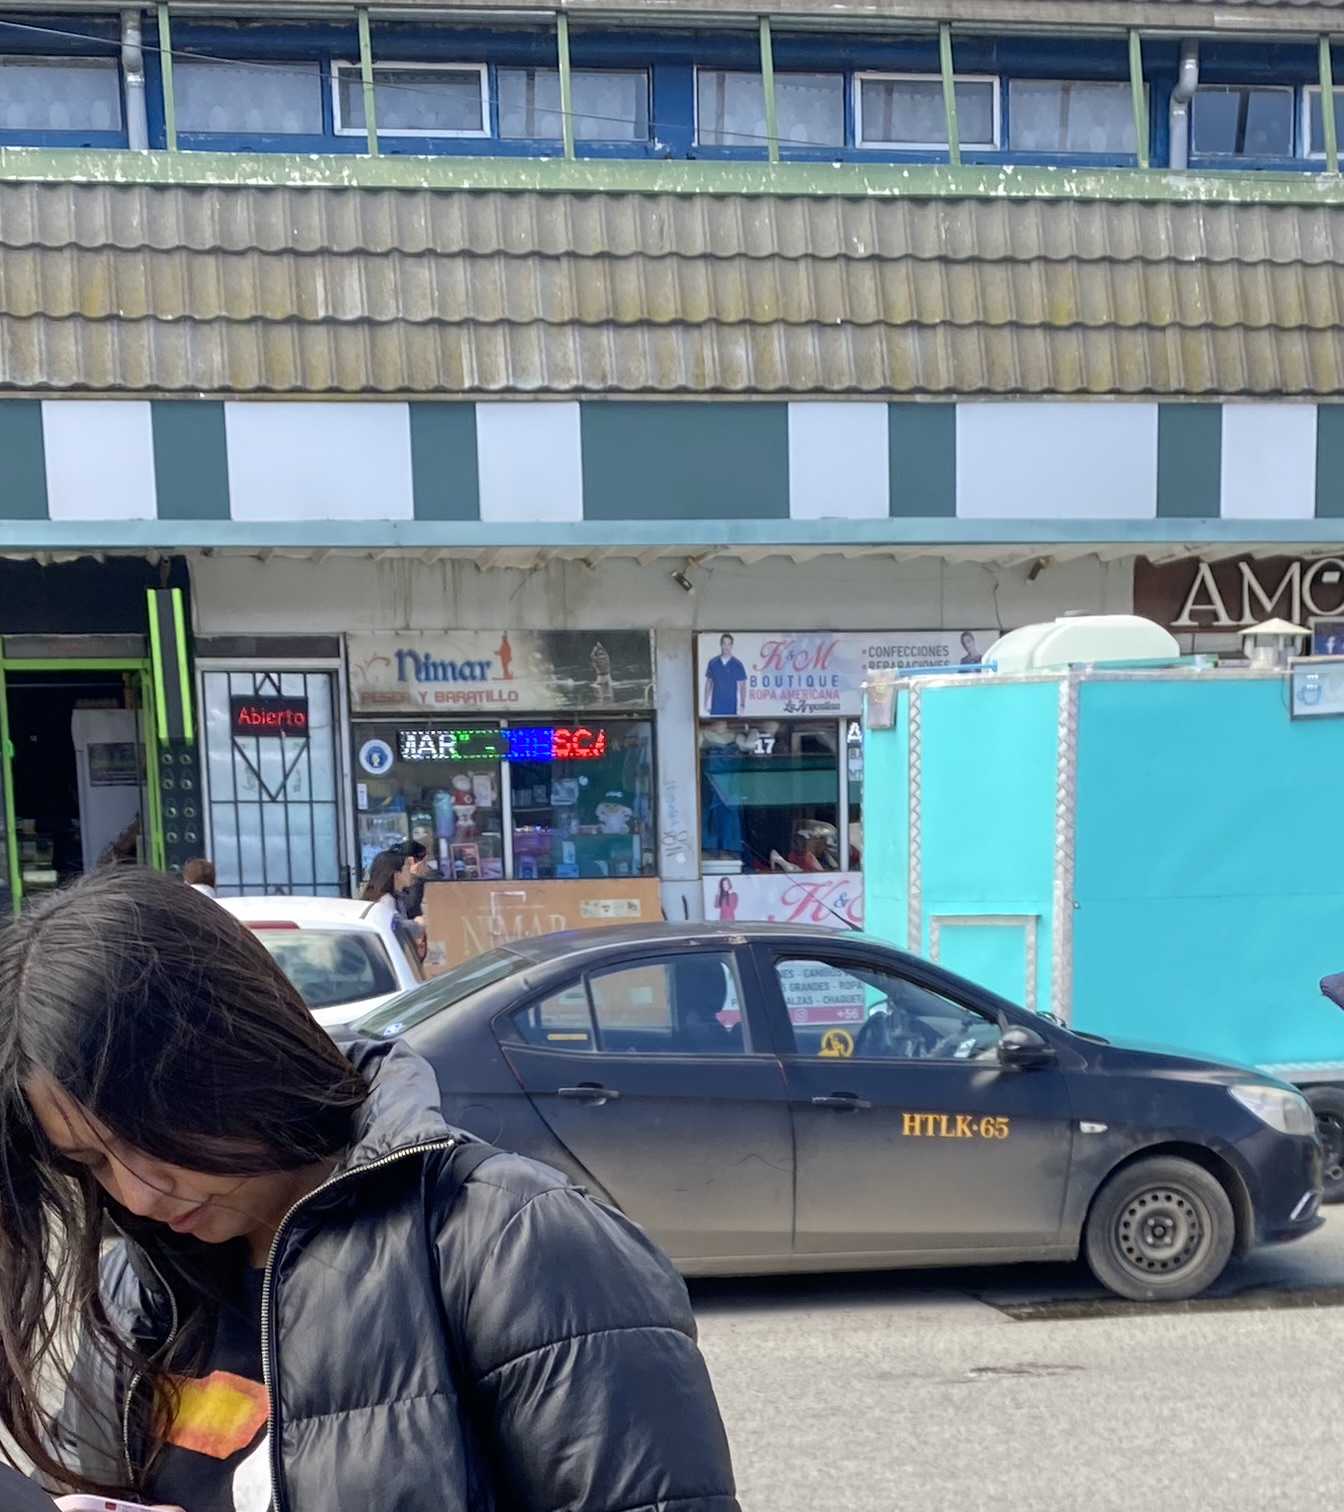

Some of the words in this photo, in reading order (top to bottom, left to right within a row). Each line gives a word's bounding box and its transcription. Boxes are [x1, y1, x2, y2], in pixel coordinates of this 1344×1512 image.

[868, 645, 950, 658] CONFECCIONES
[395, 648, 492, 682] Nimar
[749, 674, 840, 688] BOUTIQUE
[419, 690, 429, 704] Y
[434, 689, 519, 703] BARATILLO
[749, 690, 777, 700] ROPA
[780, 688, 840, 700] AMERICANA
[238, 706, 306, 726] Abierto
